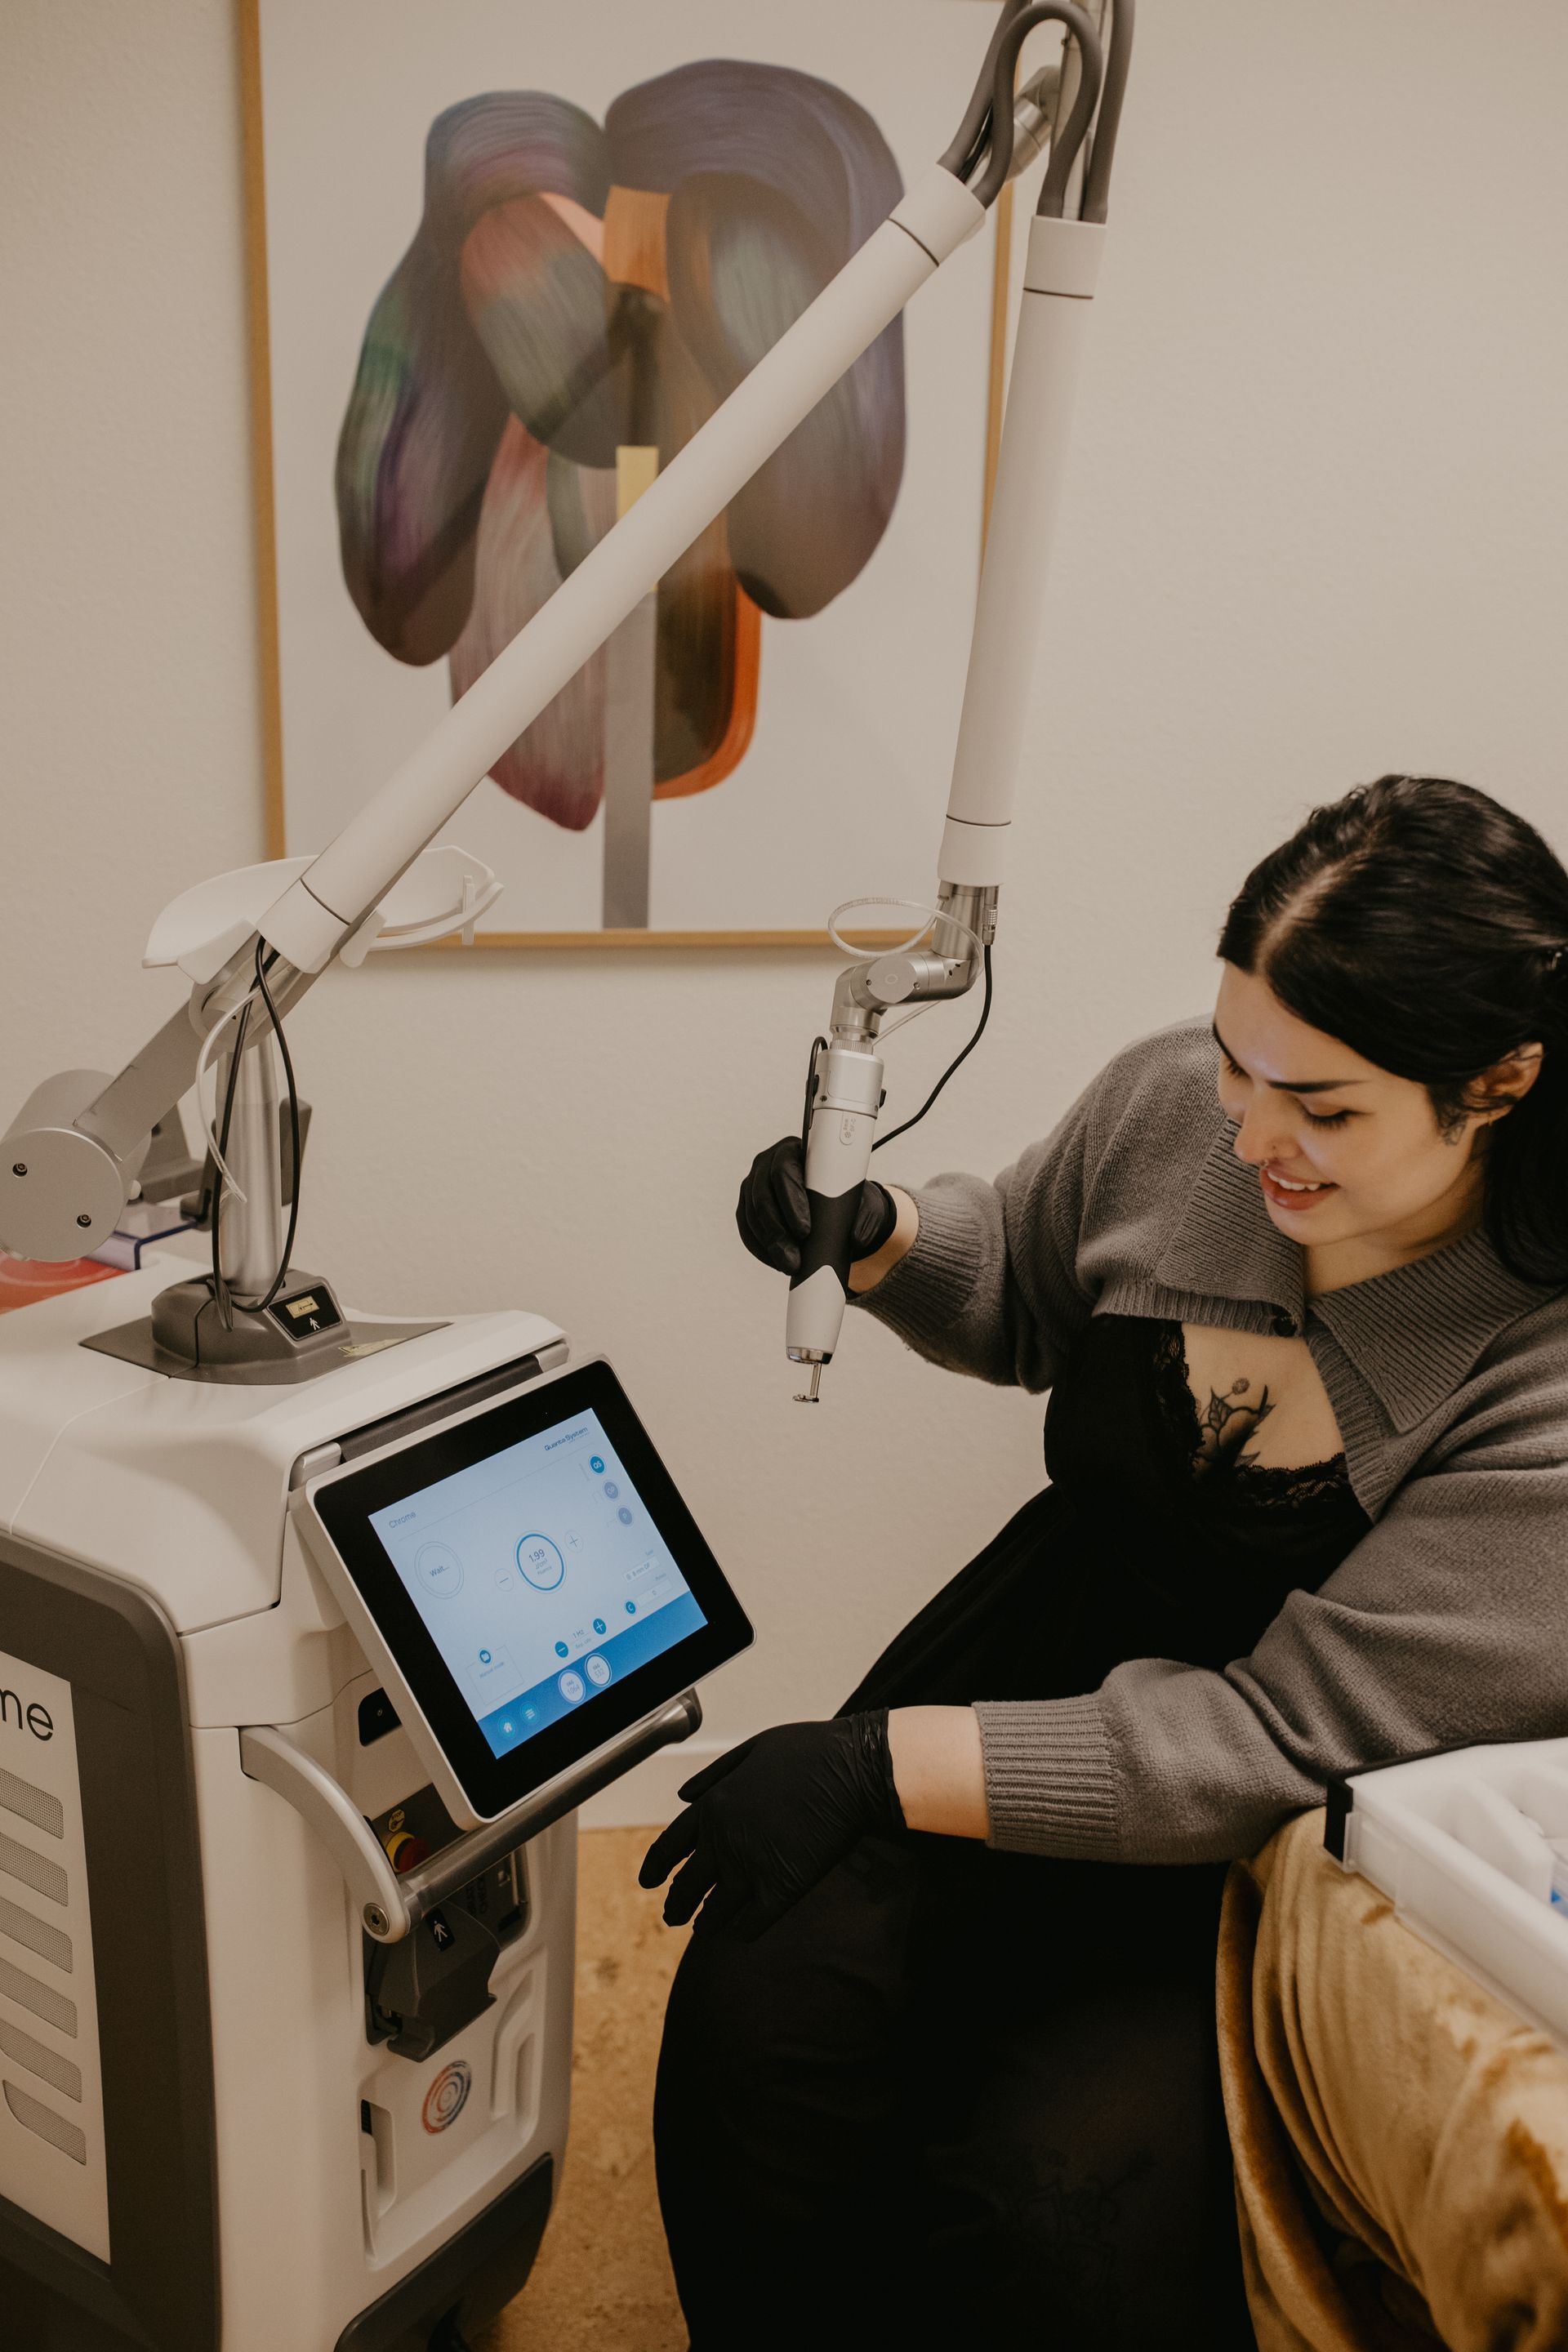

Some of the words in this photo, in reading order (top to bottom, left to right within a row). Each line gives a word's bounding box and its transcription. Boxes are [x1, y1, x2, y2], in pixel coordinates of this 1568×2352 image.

[544, 1437, 566, 1451] Quanta
[565, 1427, 588, 1440] System
[389, 1512, 416, 1529] Chrome
[529, 1548, 545, 1562] 1.99
